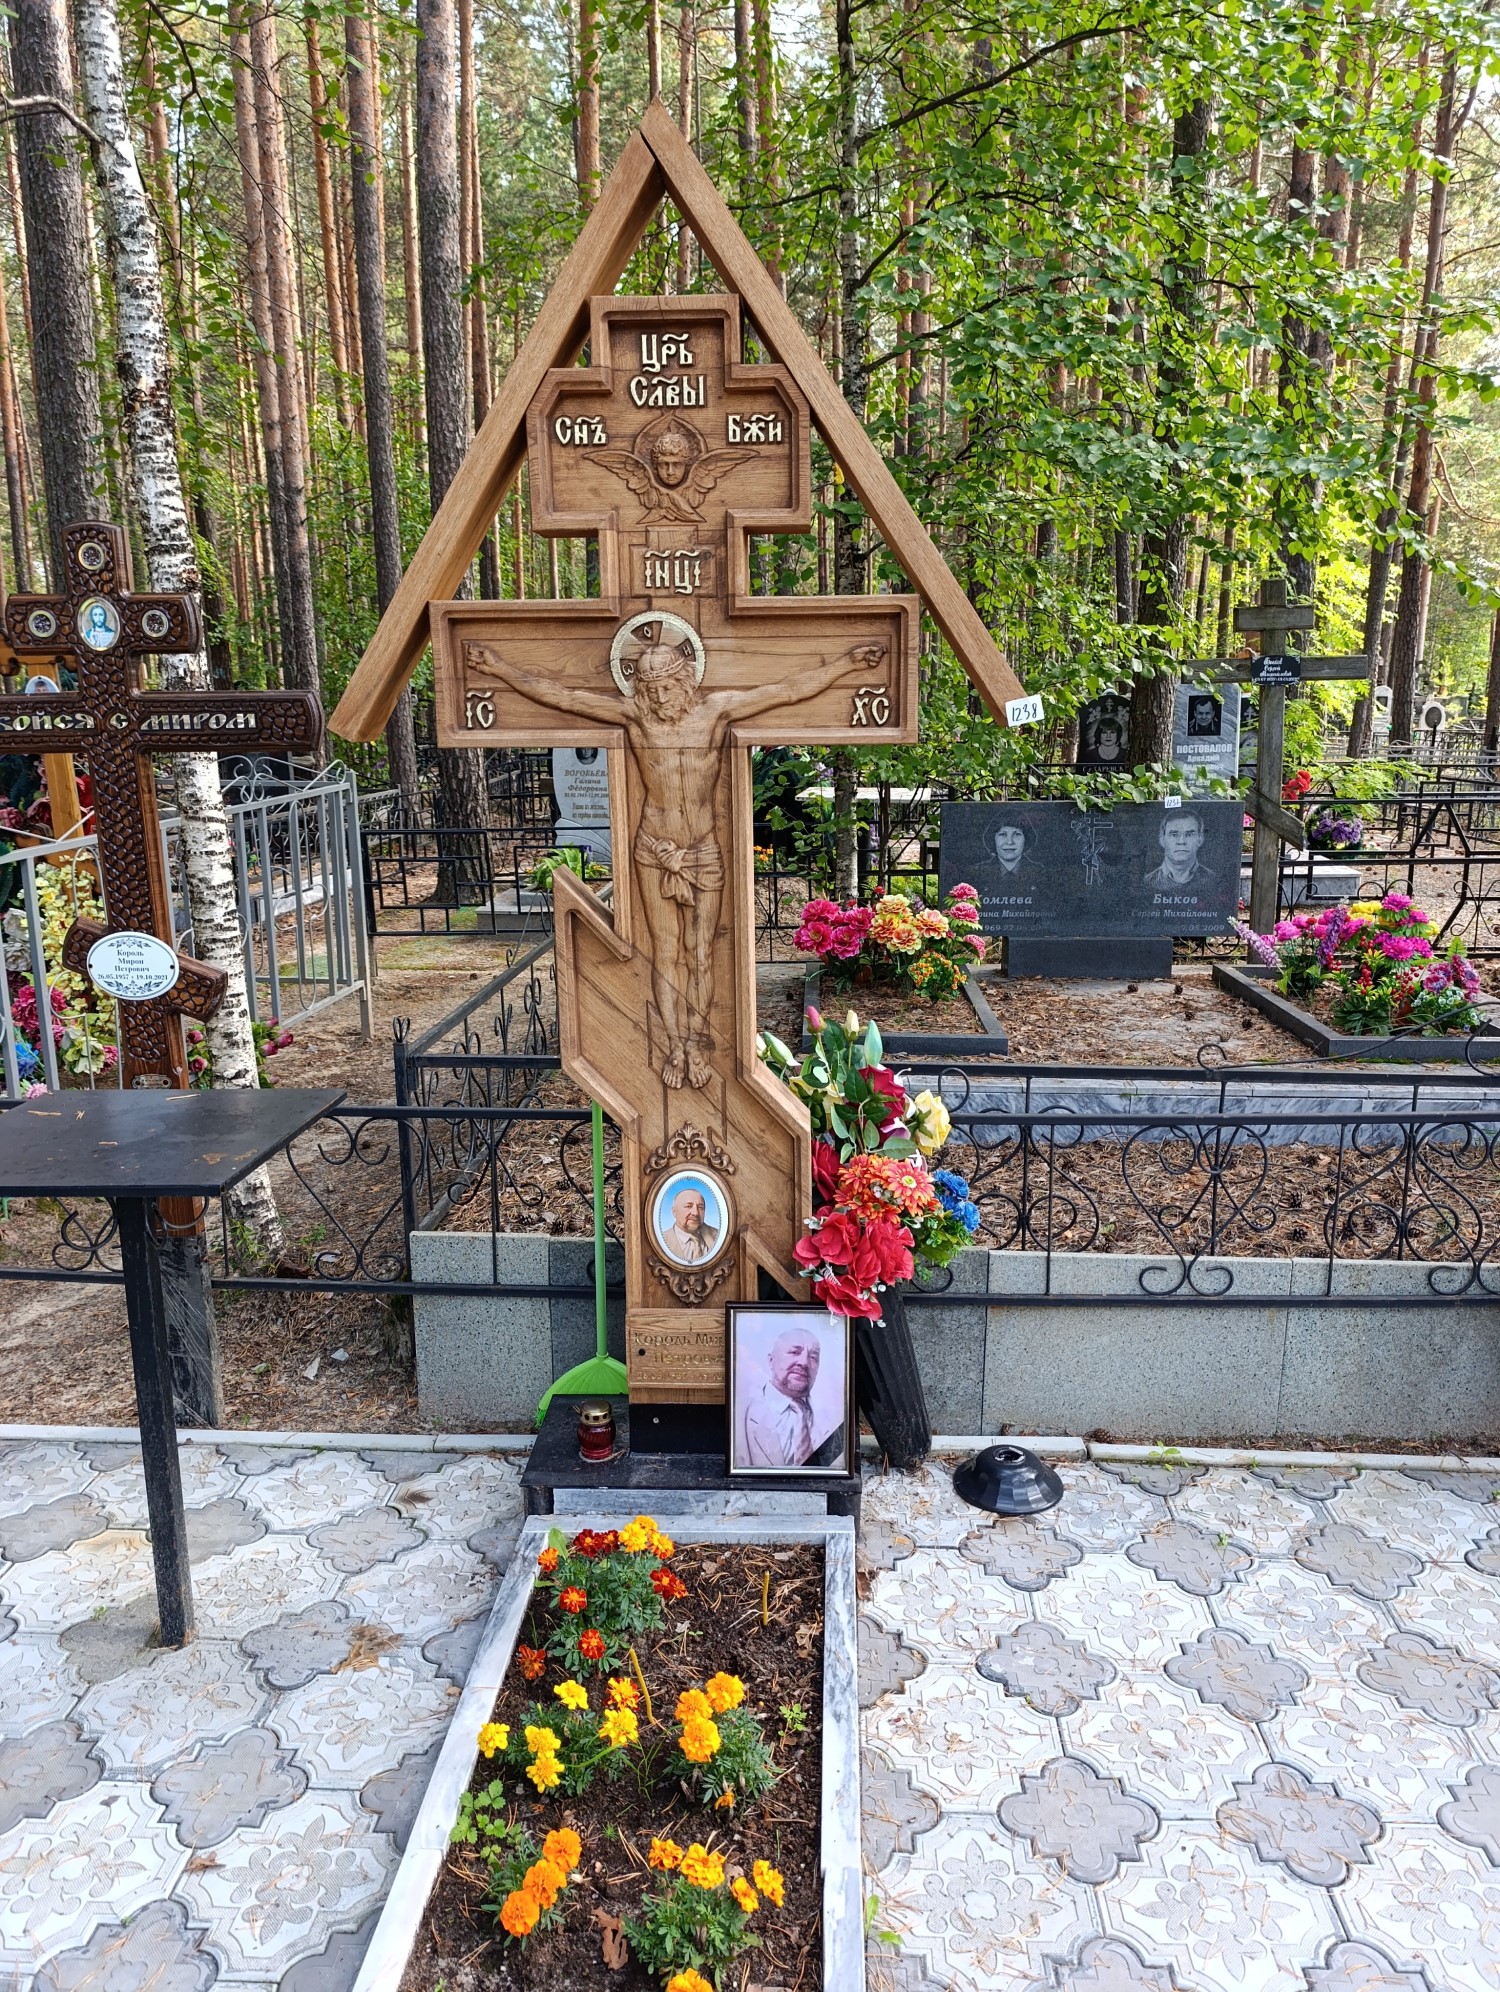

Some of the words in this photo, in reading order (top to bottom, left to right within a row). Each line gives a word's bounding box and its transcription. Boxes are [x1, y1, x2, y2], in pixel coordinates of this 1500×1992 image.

[1012, 702, 1038, 722] 1238
[1176, 743, 1233, 754] ПОСТОВАЛОВ
[979, 895, 1033, 905] омлева
[1153, 893, 1198, 904] Быков
[1131, 909, 1161, 918] Сергей
[1163, 909, 1218, 918] Михайлович
[117, 949, 145, 958] Король
[118, 958, 144, 966] Мирон
[114, 965, 150, 973] Петрович
[653, 1351, 725, 1367] Петрови
